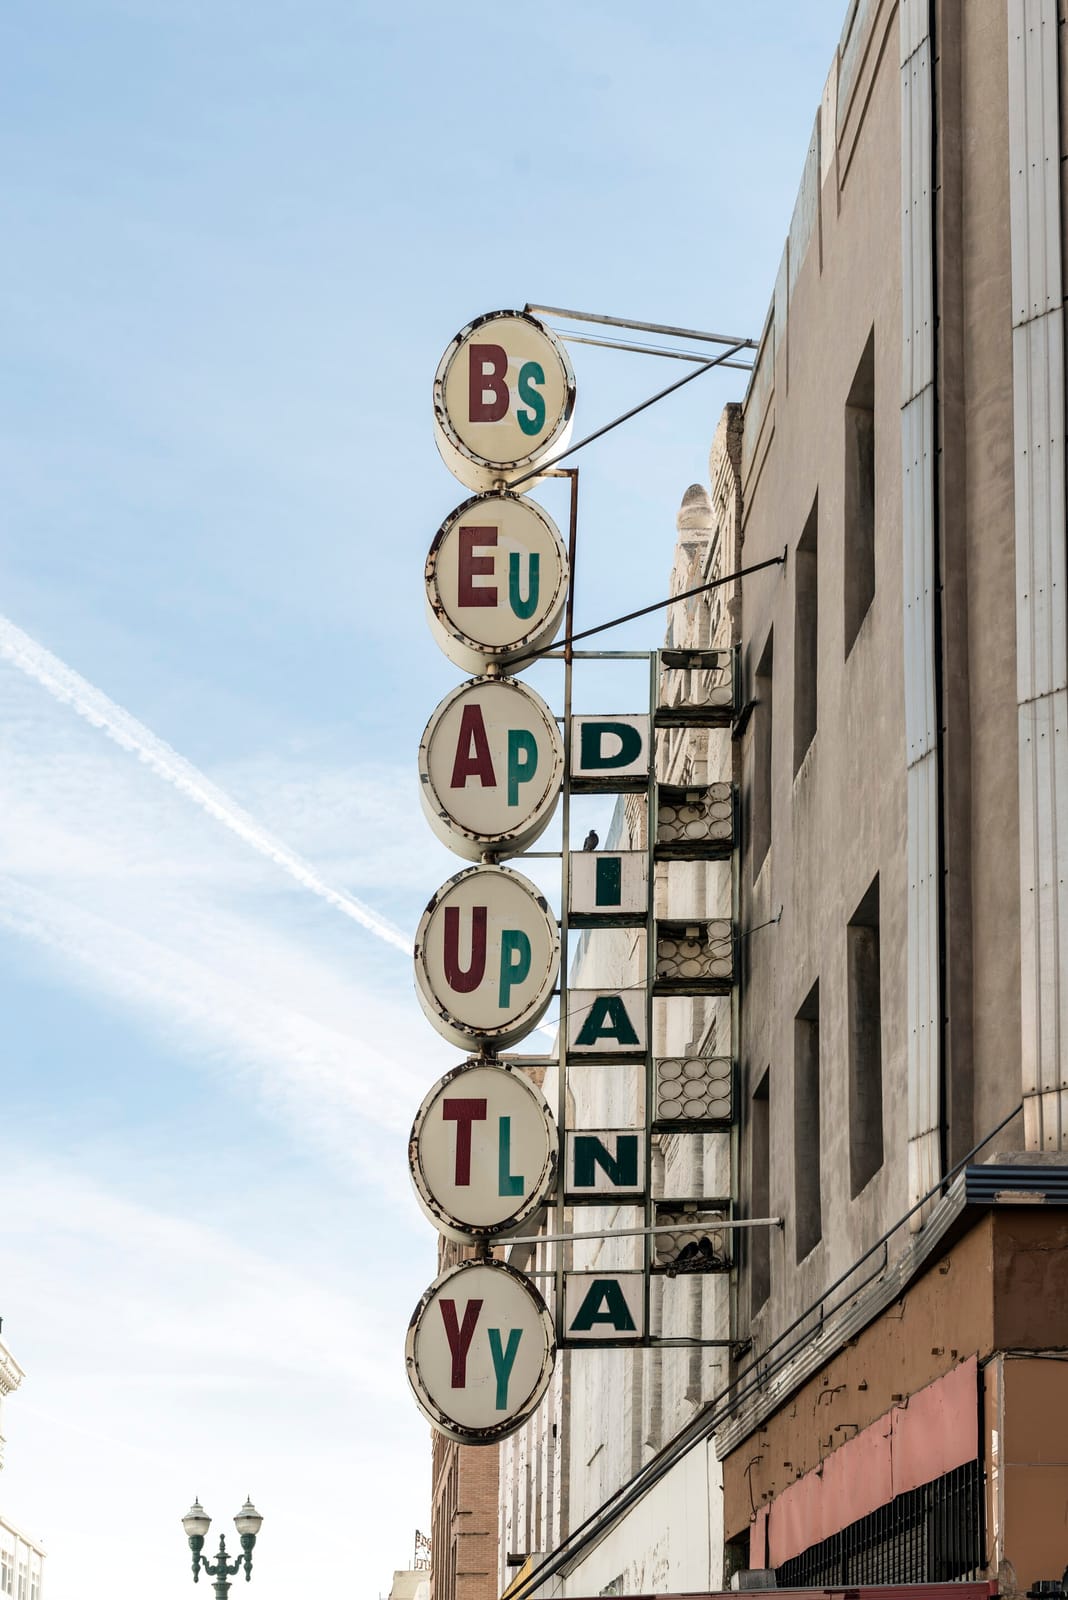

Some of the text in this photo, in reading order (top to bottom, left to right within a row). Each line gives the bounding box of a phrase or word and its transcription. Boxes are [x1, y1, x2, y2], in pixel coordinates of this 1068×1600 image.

[438, 343, 509, 1389] BEAUTY
[487, 361, 546, 1411] SUPPLY
[569, 722, 642, 1331] DIANA
